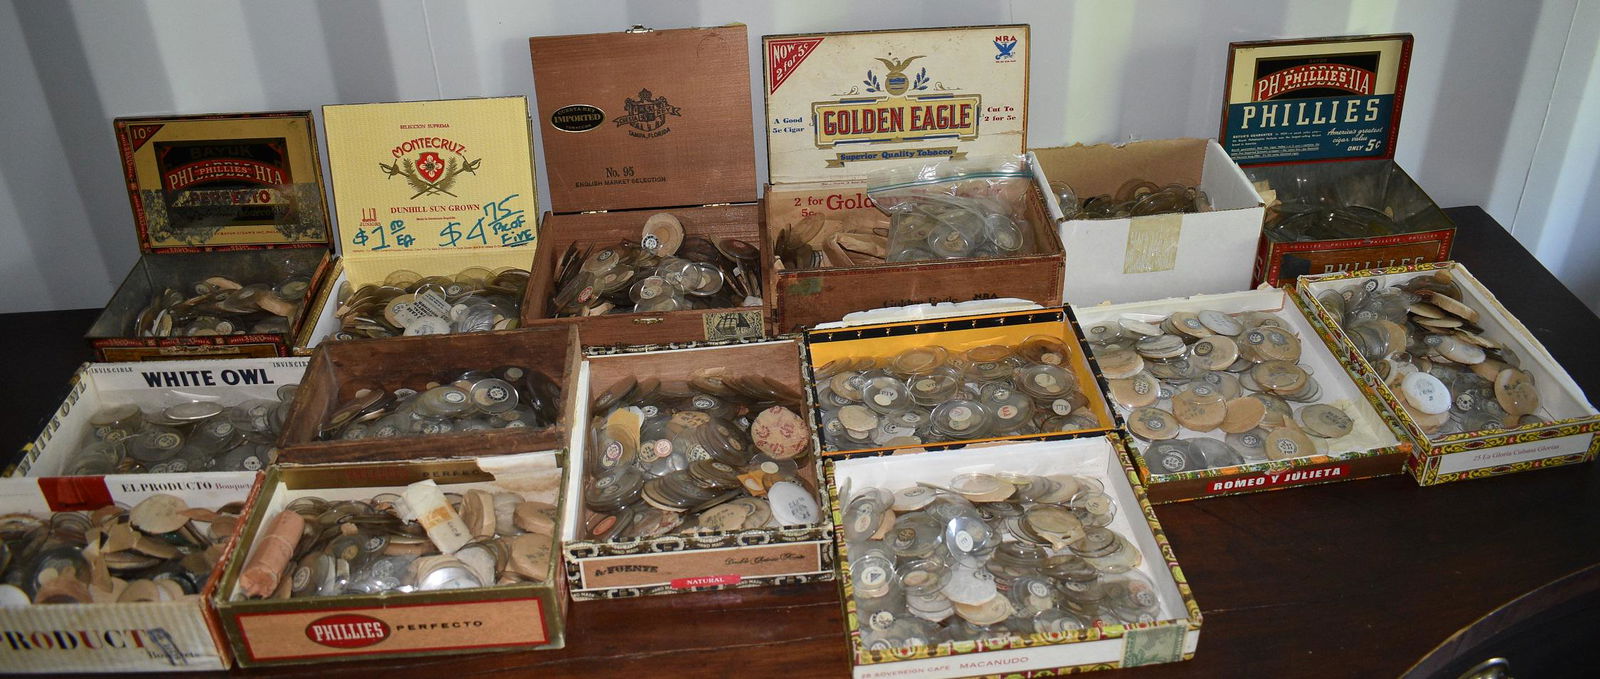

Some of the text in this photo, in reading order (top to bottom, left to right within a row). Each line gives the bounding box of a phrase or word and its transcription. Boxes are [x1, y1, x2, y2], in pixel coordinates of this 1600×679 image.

[773, 44, 796, 67] NOW
[776, 68, 783, 80] 2
[784, 53, 798, 73] for
[1284, 70, 1347, 88] PHILLIES
[553, 113, 602, 123] IMPORTED
[823, 103, 972, 136] GOLDEN EAGLE
[1241, 98, 1381, 129] PHILLIES
[1326, 126, 1384, 137] America's greatest
[1332, 137, 1349, 146] cigar
[1351, 132, 1368, 142] value
[392, 137, 466, 159] MONTECRUZ
[840, 147, 953, 163] Superior Quality Tobacco
[199, 165, 249, 175] PHILLIES
[605, 166, 635, 178] No. 95
[575, 176, 667, 188] ENGLISH MARKET SELECTION
[429, 205, 447, 213] SUN
[448, 204, 480, 212] GROWN
[793, 197, 802, 207] 2
[807, 196, 824, 206] for
[396, 234, 416, 249] EA
[142, 368, 274, 388] WHITE OWL
[16, 381, 87, 477] WHITE OWL
[421, 469, 480, 478] PERFEC
[1213, 467, 1341, 491] ROMEO Y JULIETA
[686, 577, 725, 586] NATURAL
[312, 620, 483, 642] PHILLIES PERFECTO
[874, 669, 924, 678] SOVEREIGN
[959, 656, 1029, 669] MACANUDO
